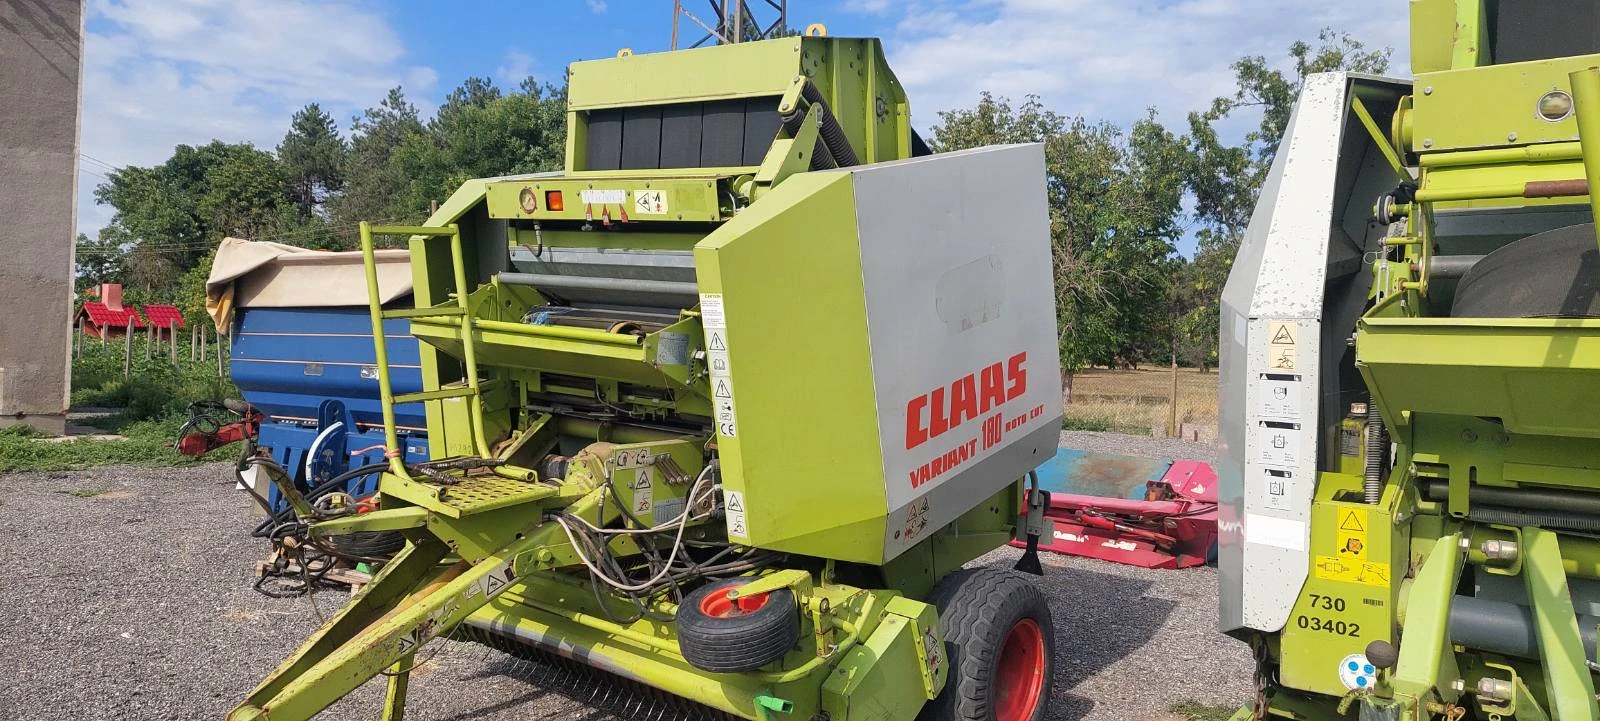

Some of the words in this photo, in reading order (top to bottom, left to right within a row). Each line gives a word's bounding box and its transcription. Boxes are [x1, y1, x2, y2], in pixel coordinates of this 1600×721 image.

[905, 351, 1027, 450] CLAAS
[909, 438, 978, 489] VARIANT
[981, 412, 1003, 451] 180
[1005, 413, 1028, 433] ROTO
[1030, 404, 1045, 420] CUT
[1297, 615, 1360, 638] 03402
[1309, 594, 1346, 612] 730
